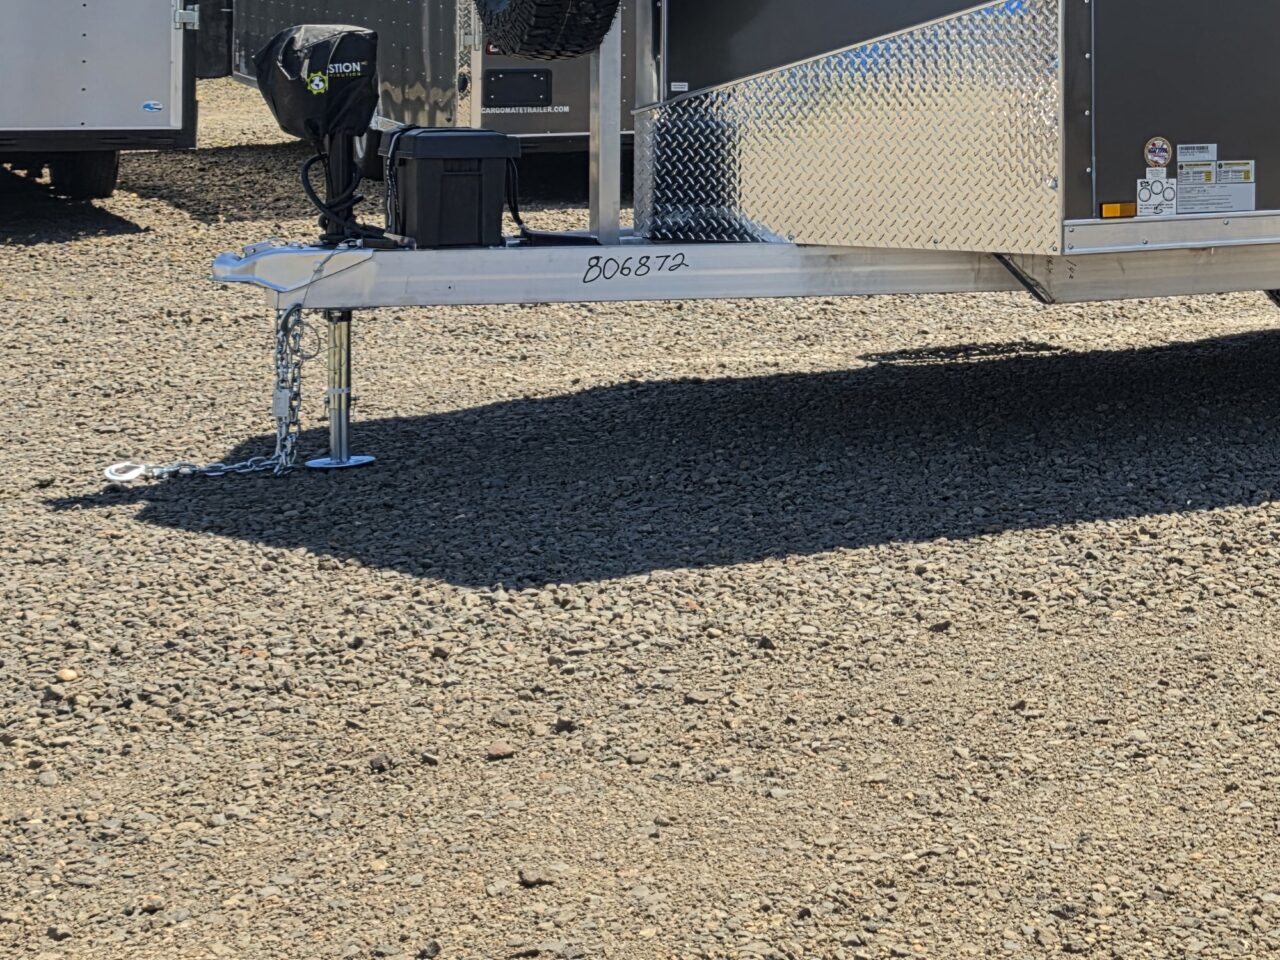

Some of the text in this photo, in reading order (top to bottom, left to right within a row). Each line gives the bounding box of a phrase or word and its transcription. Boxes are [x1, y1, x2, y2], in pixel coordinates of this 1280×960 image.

[327, 62, 361, 73] STION
[481, 105, 570, 114] CARGOMATETRAILER.COM
[583, 252, 689, 284] 806872
